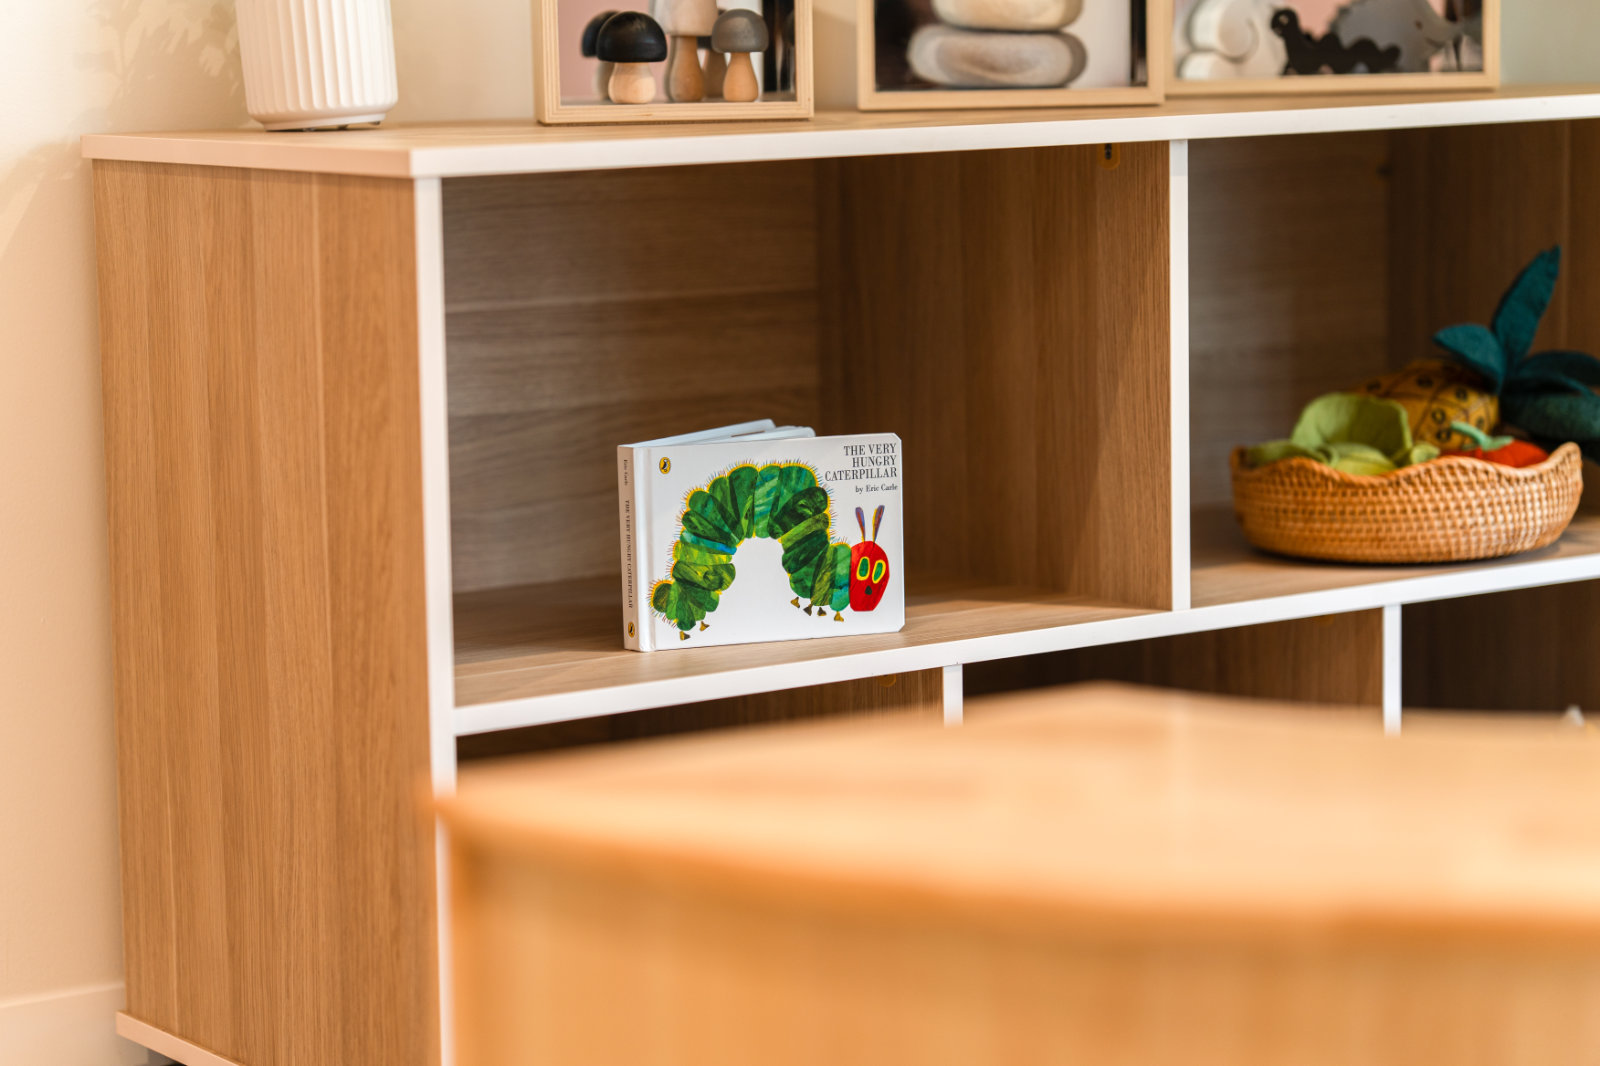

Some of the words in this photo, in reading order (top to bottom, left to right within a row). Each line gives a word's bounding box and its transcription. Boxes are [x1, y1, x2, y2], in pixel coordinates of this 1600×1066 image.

[844, 445, 866, 456] THE
[868, 443, 897, 454] VERY
[852, 455, 897, 468] HUNGRY
[824, 467, 897, 481] CATERPILLAR
[855, 485, 863, 494] by
[865, 484, 879, 492] Eric
[880, 483, 898, 491] Carle
